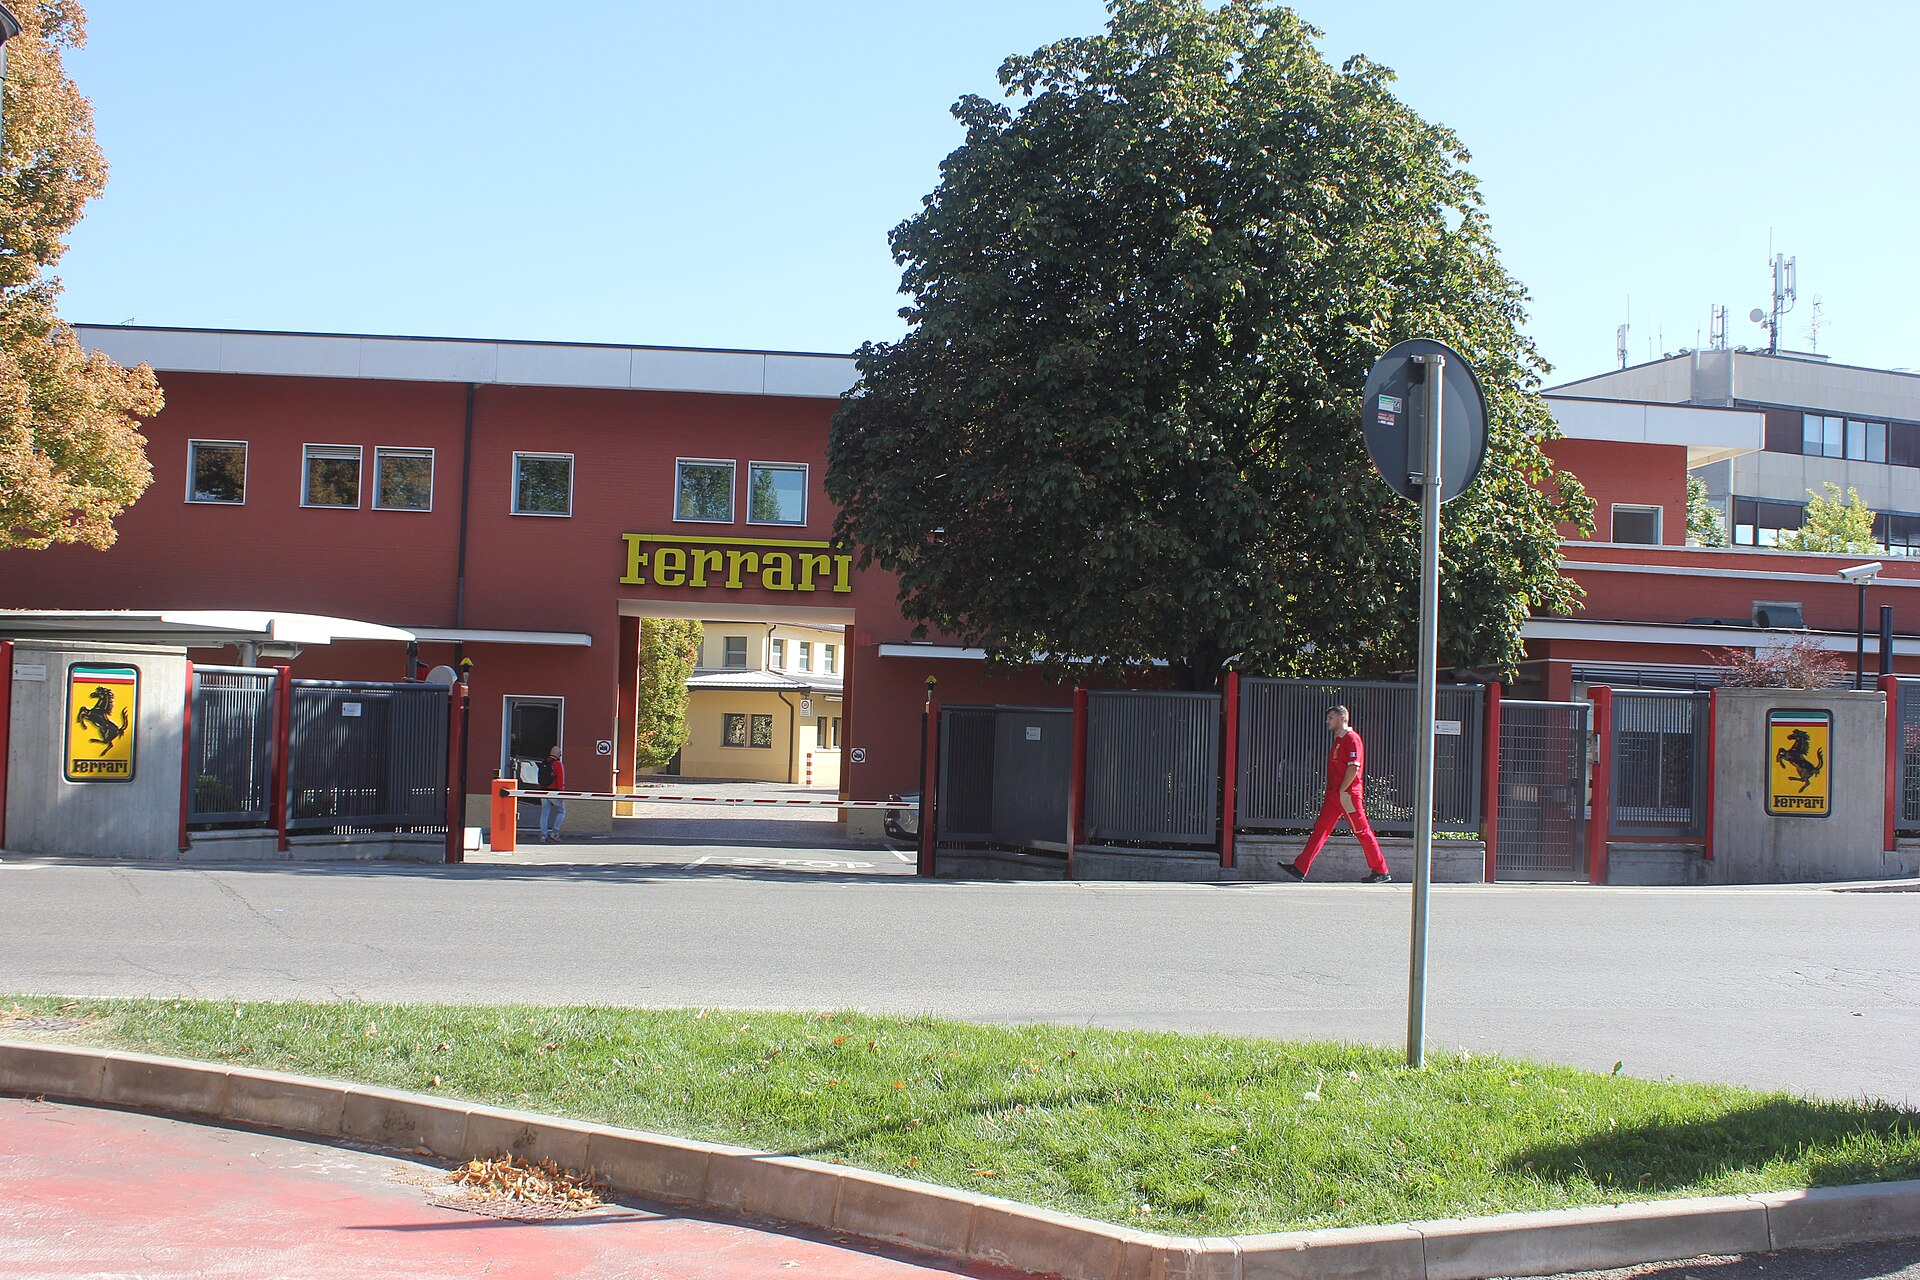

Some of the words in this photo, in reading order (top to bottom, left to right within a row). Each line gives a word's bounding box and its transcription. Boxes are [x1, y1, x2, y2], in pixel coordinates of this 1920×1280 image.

[619, 533, 853, 593] Ferrari
[72, 758, 128, 773] Ferrari
[1773, 794, 1824, 809] Ferrari
[730, 857, 876, 869] STOP
